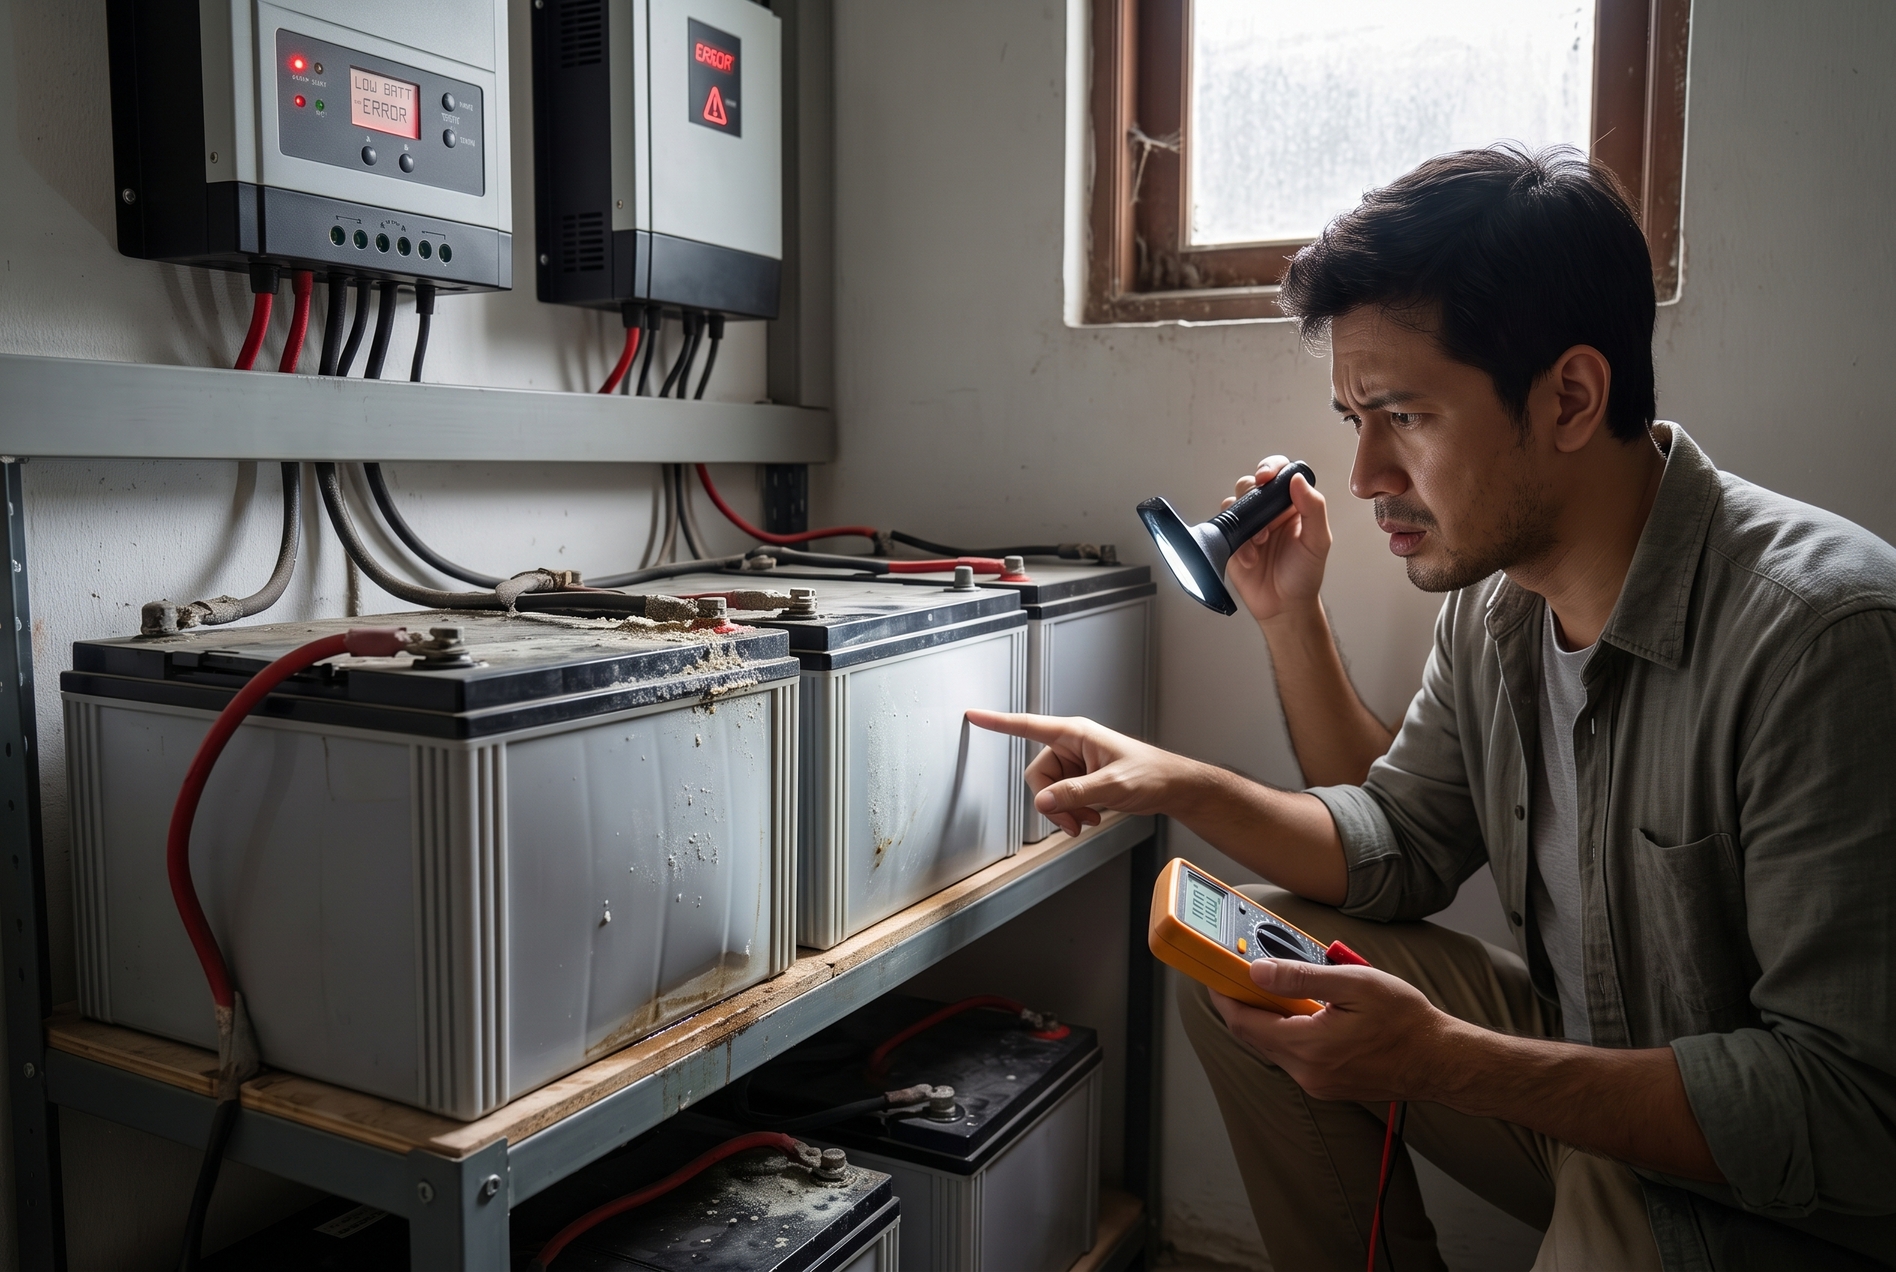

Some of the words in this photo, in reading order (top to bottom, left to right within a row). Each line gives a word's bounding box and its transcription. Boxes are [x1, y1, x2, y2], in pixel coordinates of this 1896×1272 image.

[354, 75, 377, 93] LOW
[384, 82, 412, 101] BATT
[363, 97, 407, 124] ERROR
